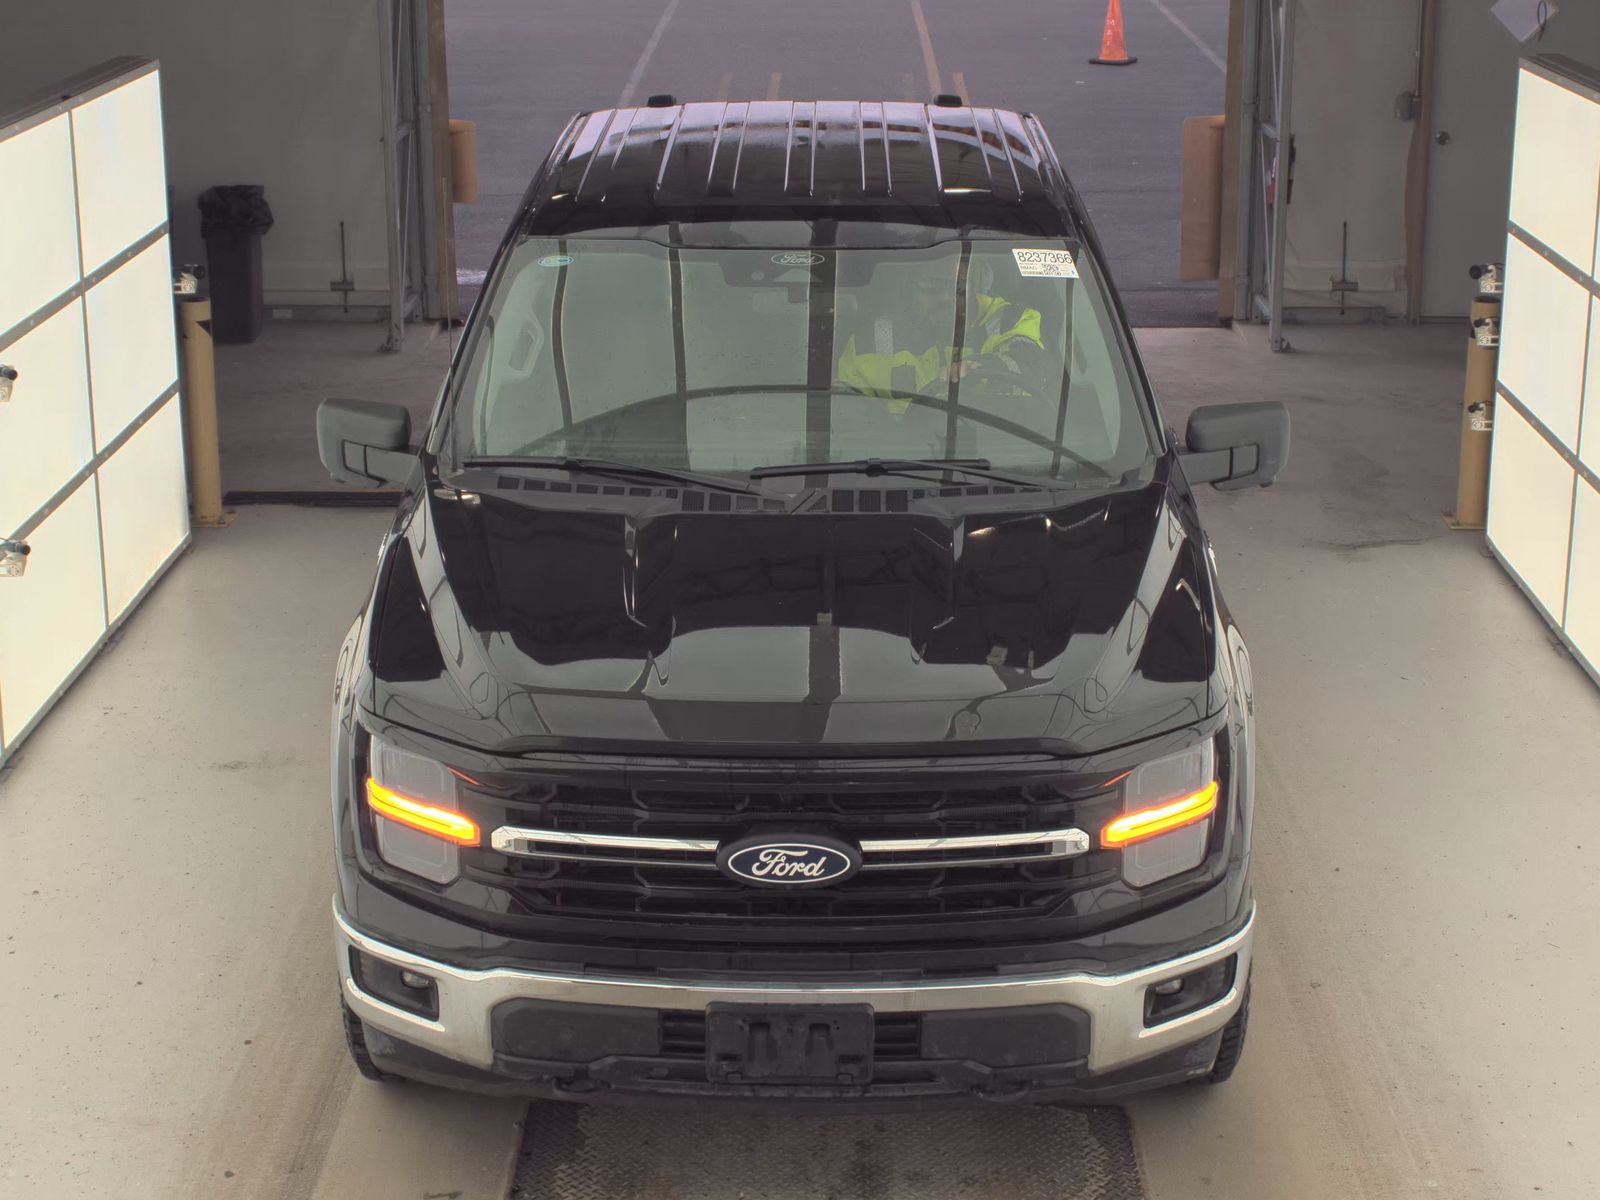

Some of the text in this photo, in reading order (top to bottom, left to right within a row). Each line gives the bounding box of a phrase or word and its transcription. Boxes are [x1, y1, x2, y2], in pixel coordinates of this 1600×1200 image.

[780, 253, 816, 264] Ford
[1017, 251, 1073, 264] 8237366
[751, 848, 827, 877] Ford
